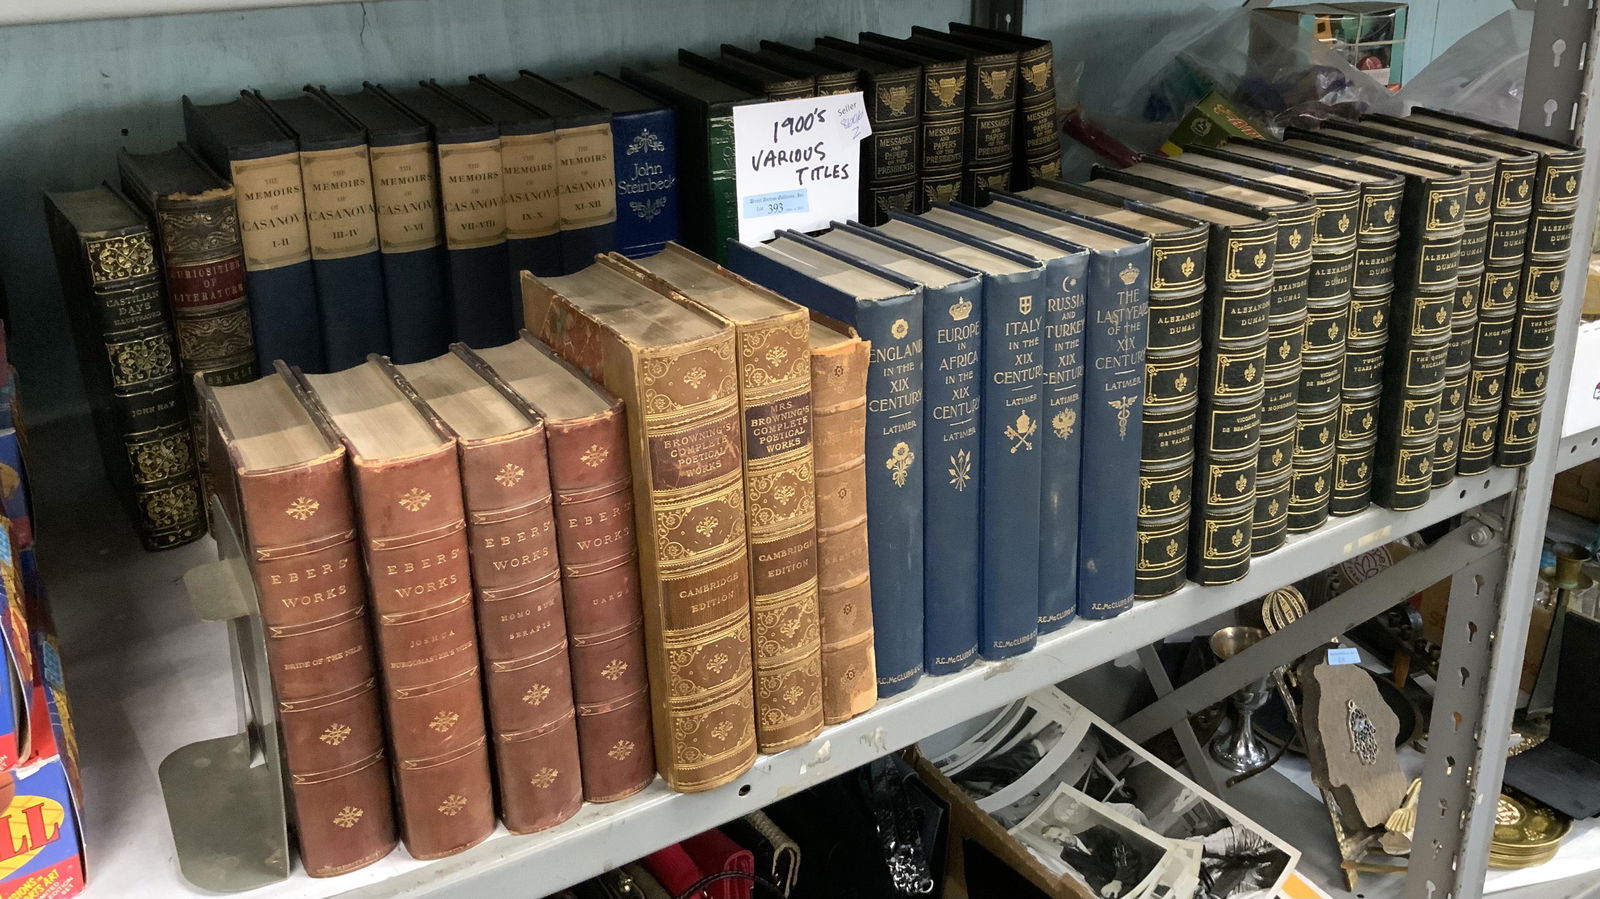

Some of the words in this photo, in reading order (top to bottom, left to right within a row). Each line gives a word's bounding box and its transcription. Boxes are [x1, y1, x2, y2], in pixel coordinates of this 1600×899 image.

[838, 102, 857, 117] Seller
[774, 107, 826, 143] 1900's
[928, 126, 961, 138] MESSAGES
[879, 135, 913, 147] MESSAGES
[560, 153, 607, 167] MEMOIRS
[752, 141, 826, 172] VARIOUS
[502, 163, 553, 175] MEMOIRS
[631, 163, 663, 181] John
[796, 163, 849, 186] TITLES
[313, 178, 366, 192] MEMOIRS
[381, 174, 433, 187] MEMOIRS
[448, 171, 499, 184] MEMOIRS
[244, 186, 300, 201] MEMOIRS
[618, 176, 676, 197] Steinbeck
[768, 202, 784, 215] 393
[203, 279, 217, 288] OF
[106, 289, 160, 309] CASTILIAN
[1048, 293, 1085, 313] RUSSIA
[1117, 288, 1140, 306] THE
[1277, 293, 1301, 304] DUMAS
[119, 303, 151, 316] DAYS
[1061, 312, 1076, 320] AND
[1096, 308, 1125, 324] LAST
[1005, 316, 1043, 337] ITALY
[1241, 315, 1266, 327] DUMAS
[937, 321, 980, 345] EUROPE
[1107, 327, 1121, 337] OF
[1124, 322, 1141, 334] THE
[1169, 323, 1196, 336] DUMAS
[957, 341, 967, 351] IN
[1009, 341, 1019, 351] IN
[1022, 337, 1039, 348] THE
[1054, 342, 1063, 351] IN
[1063, 339, 1080, 350] THE
[1117, 336, 1136, 352] XIX
[939, 351, 979, 372] AFRICA
[1014, 352, 1033, 366] XIX
[1058, 353, 1076, 368] XIX
[884, 367, 894, 378] IN
[896, 361, 915, 374] THE
[945, 375, 955, 385] IN
[958, 370, 974, 383] THE
[890, 377, 910, 394] XIX
[1105, 377, 1142, 392] LATIMER
[869, 389, 923, 413] CENTURY
[952, 386, 970, 401] XIX
[1006, 393, 1038, 407] LATIMER
[1050, 393, 1079, 407] LATIMER
[132, 406, 155, 418] JOHN
[770, 401, 792, 413] MRS
[751, 405, 810, 428] BROWNING'S
[753, 415, 808, 437] COMPLETE
[883, 420, 917, 436] LATIMER
[943, 426, 977, 442] LATIMER
[664, 423, 731, 452] BROWNING'S
[759, 428, 806, 445] POETICAL
[670, 434, 729, 459] COMPLETE
[766, 438, 802, 454] WORKS
[677, 447, 727, 468] POETICAL
[685, 460, 723, 479] WORKS
[577, 527, 630, 551] WORKS
[493, 547, 549, 571] WORKS
[768, 559, 809, 579] EDITION
[395, 574, 458, 599] WORKS
[679, 571, 739, 599] CAMBRIDGE
[282, 585, 347, 609] WORKS
[691, 589, 735, 614] EDITION
[509, 621, 551, 640] SERAPIS
[409, 630, 456, 648] JOSHUA
[284, 662, 311, 673] BRIDE
[312, 658, 323, 667] OF
[326, 653, 344, 665] THE
